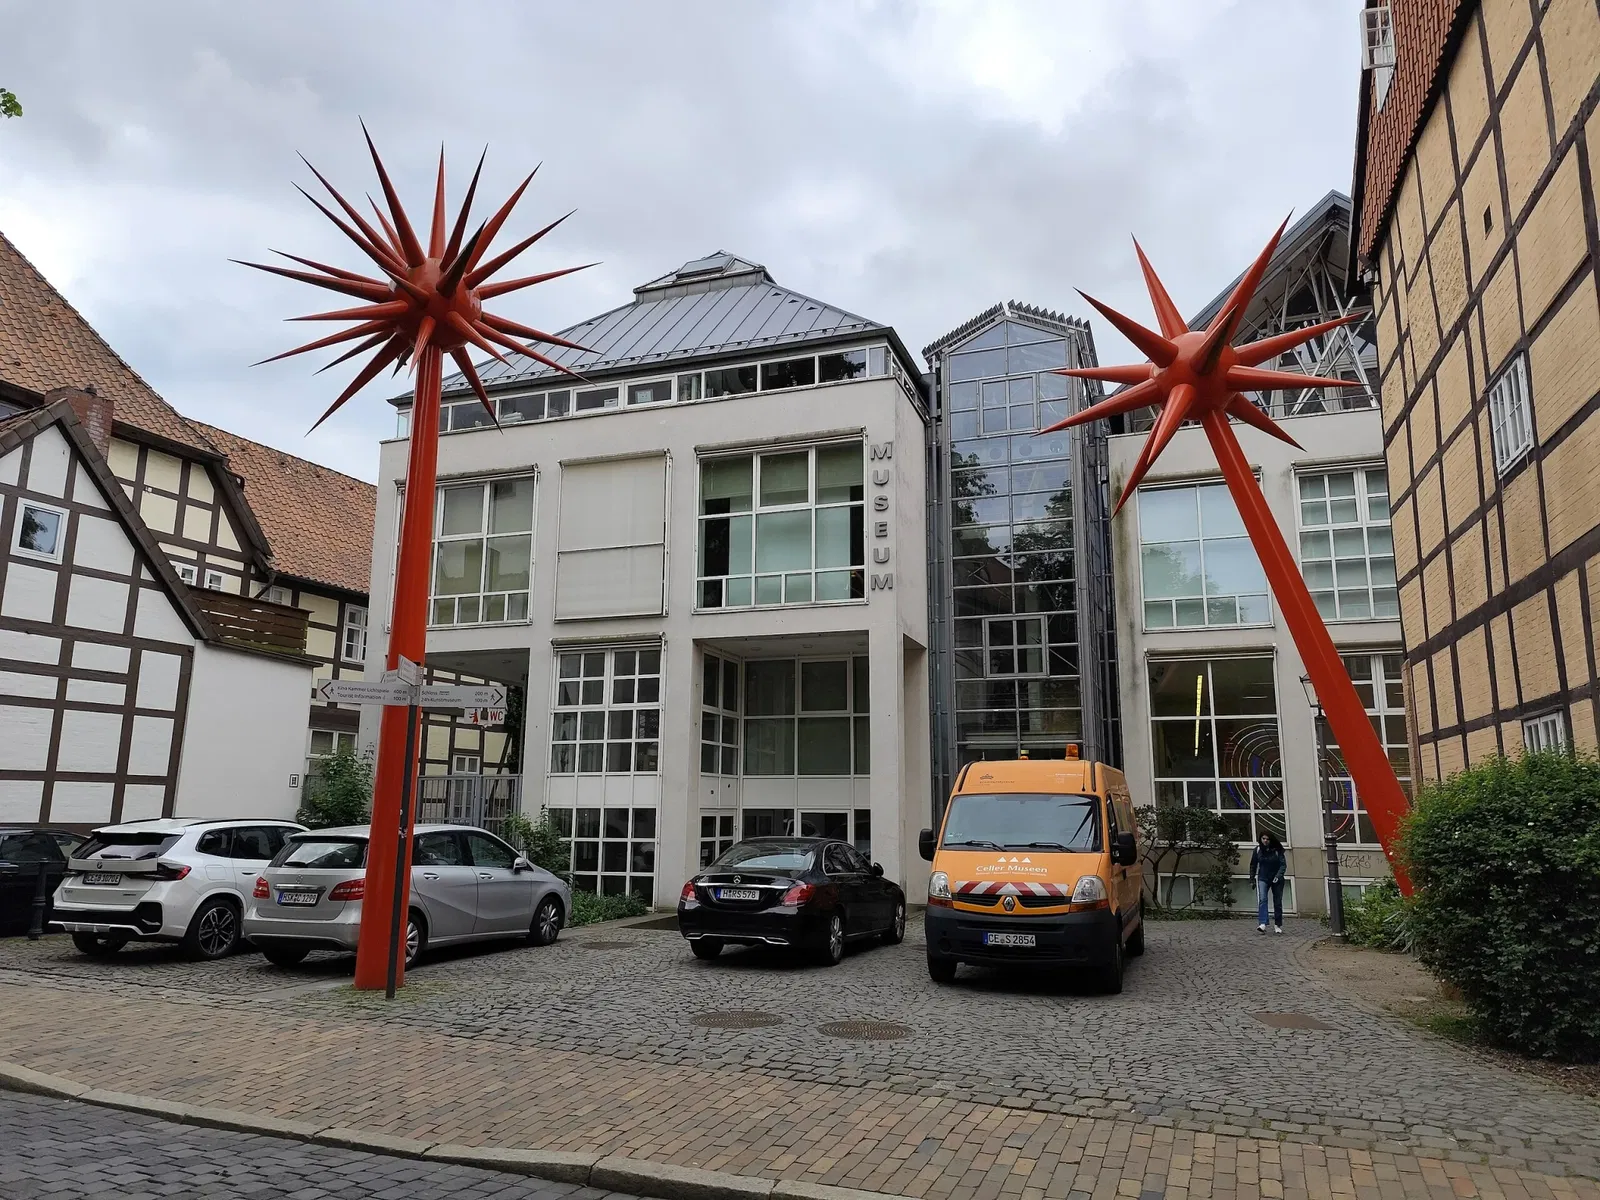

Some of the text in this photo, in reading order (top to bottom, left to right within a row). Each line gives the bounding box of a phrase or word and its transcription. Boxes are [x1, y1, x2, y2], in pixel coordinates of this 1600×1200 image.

[870, 441, 893, 590] MUSEUM
[490, 711, 503, 721] WC
[1007, 865, 1048, 873] Museen
